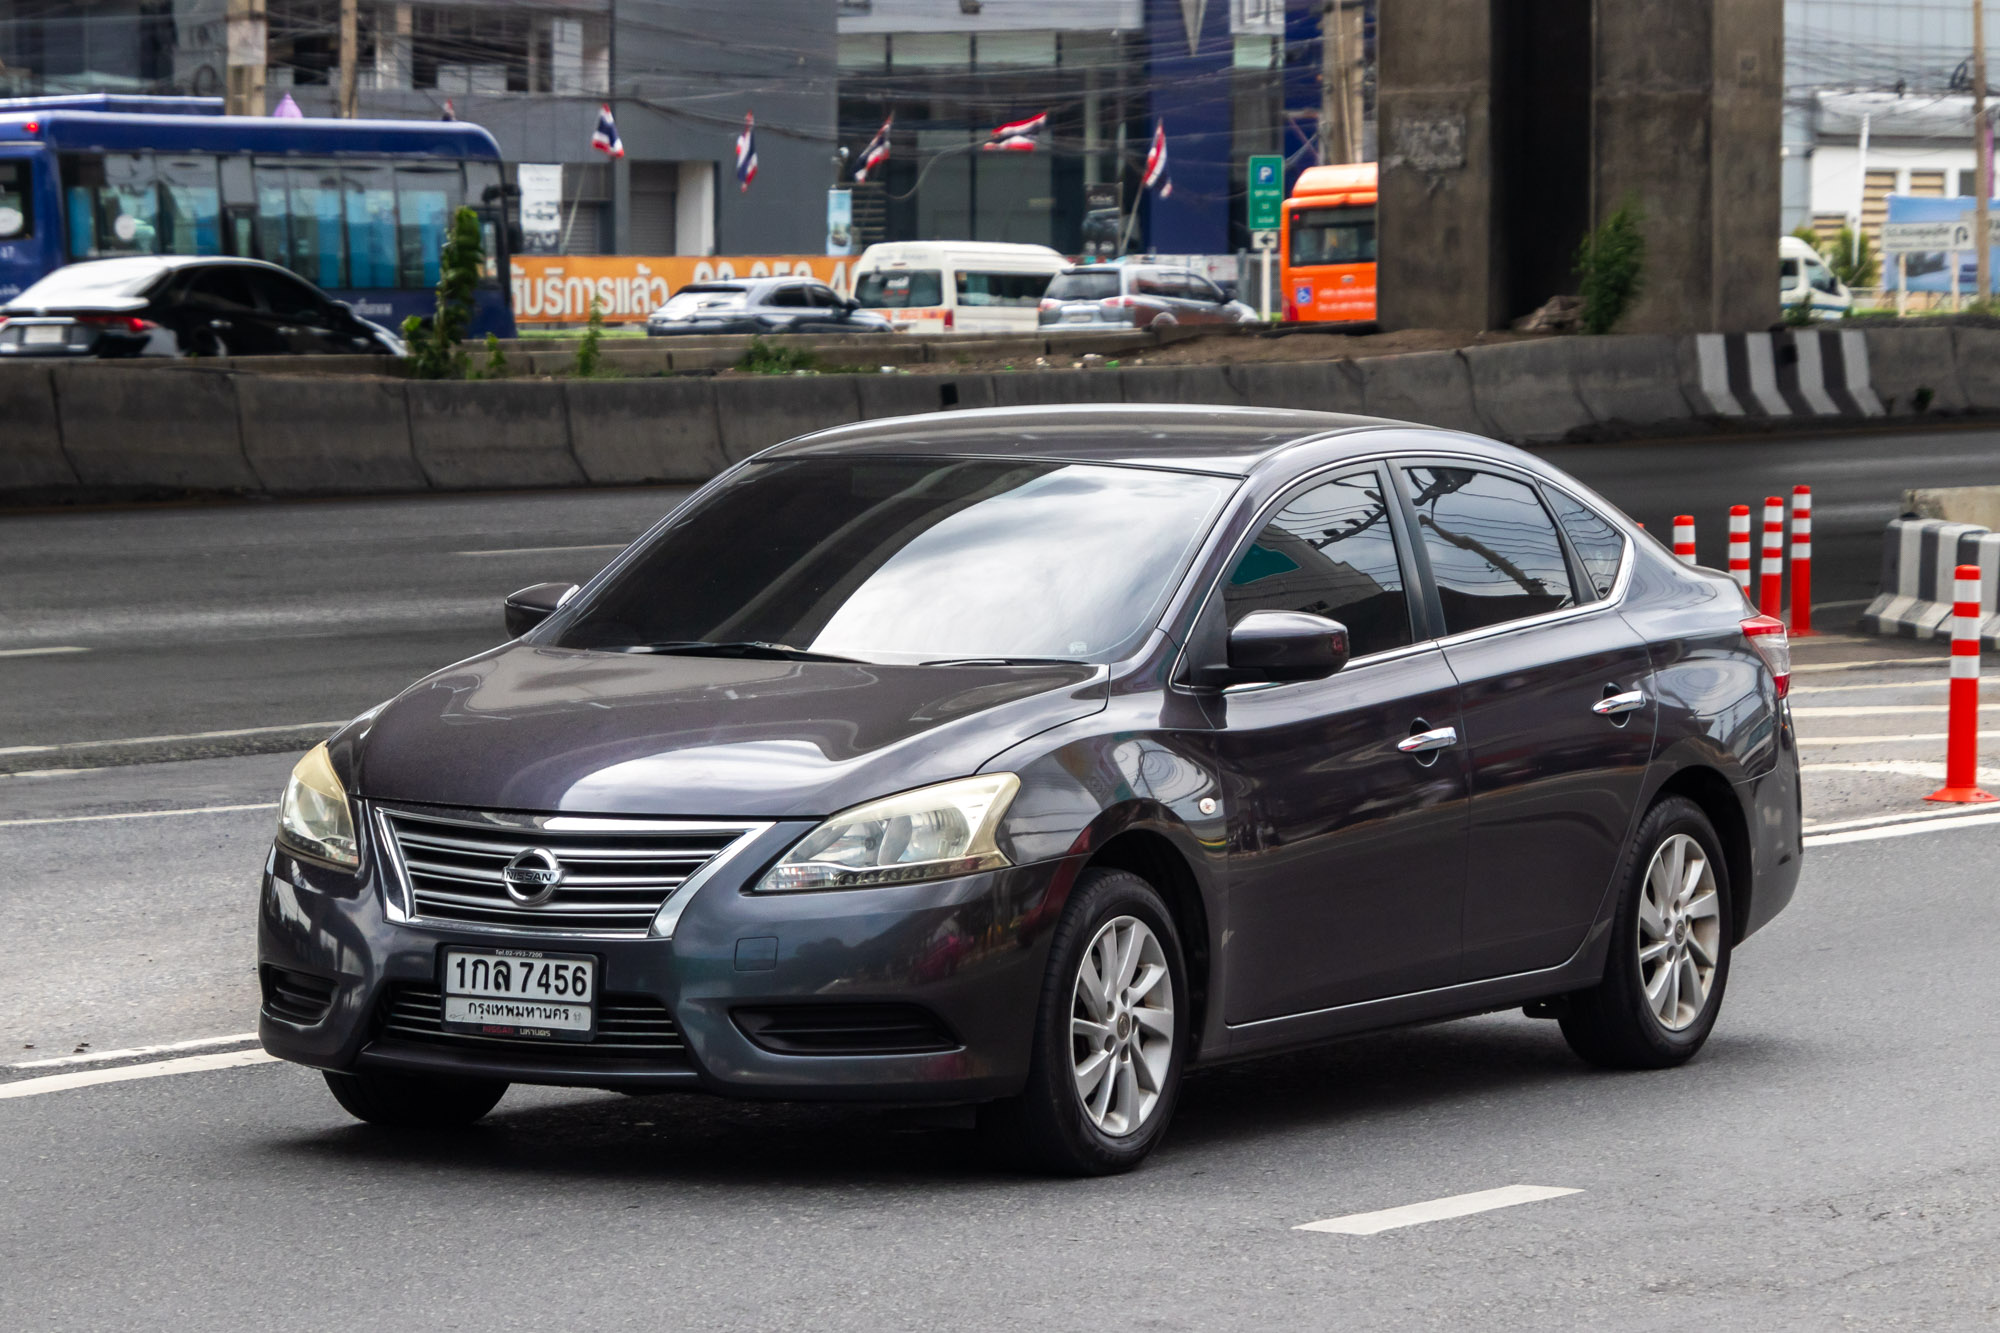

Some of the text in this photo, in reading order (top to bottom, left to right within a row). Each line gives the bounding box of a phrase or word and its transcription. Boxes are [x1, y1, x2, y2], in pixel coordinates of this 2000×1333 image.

[1259, 166, 1273, 181] P
[506, 870, 552, 881] NISSAN
[456, 957, 587, 997] 1กล 7456
[468, 1002, 570, 1020] กรุงเทพมหานคร
